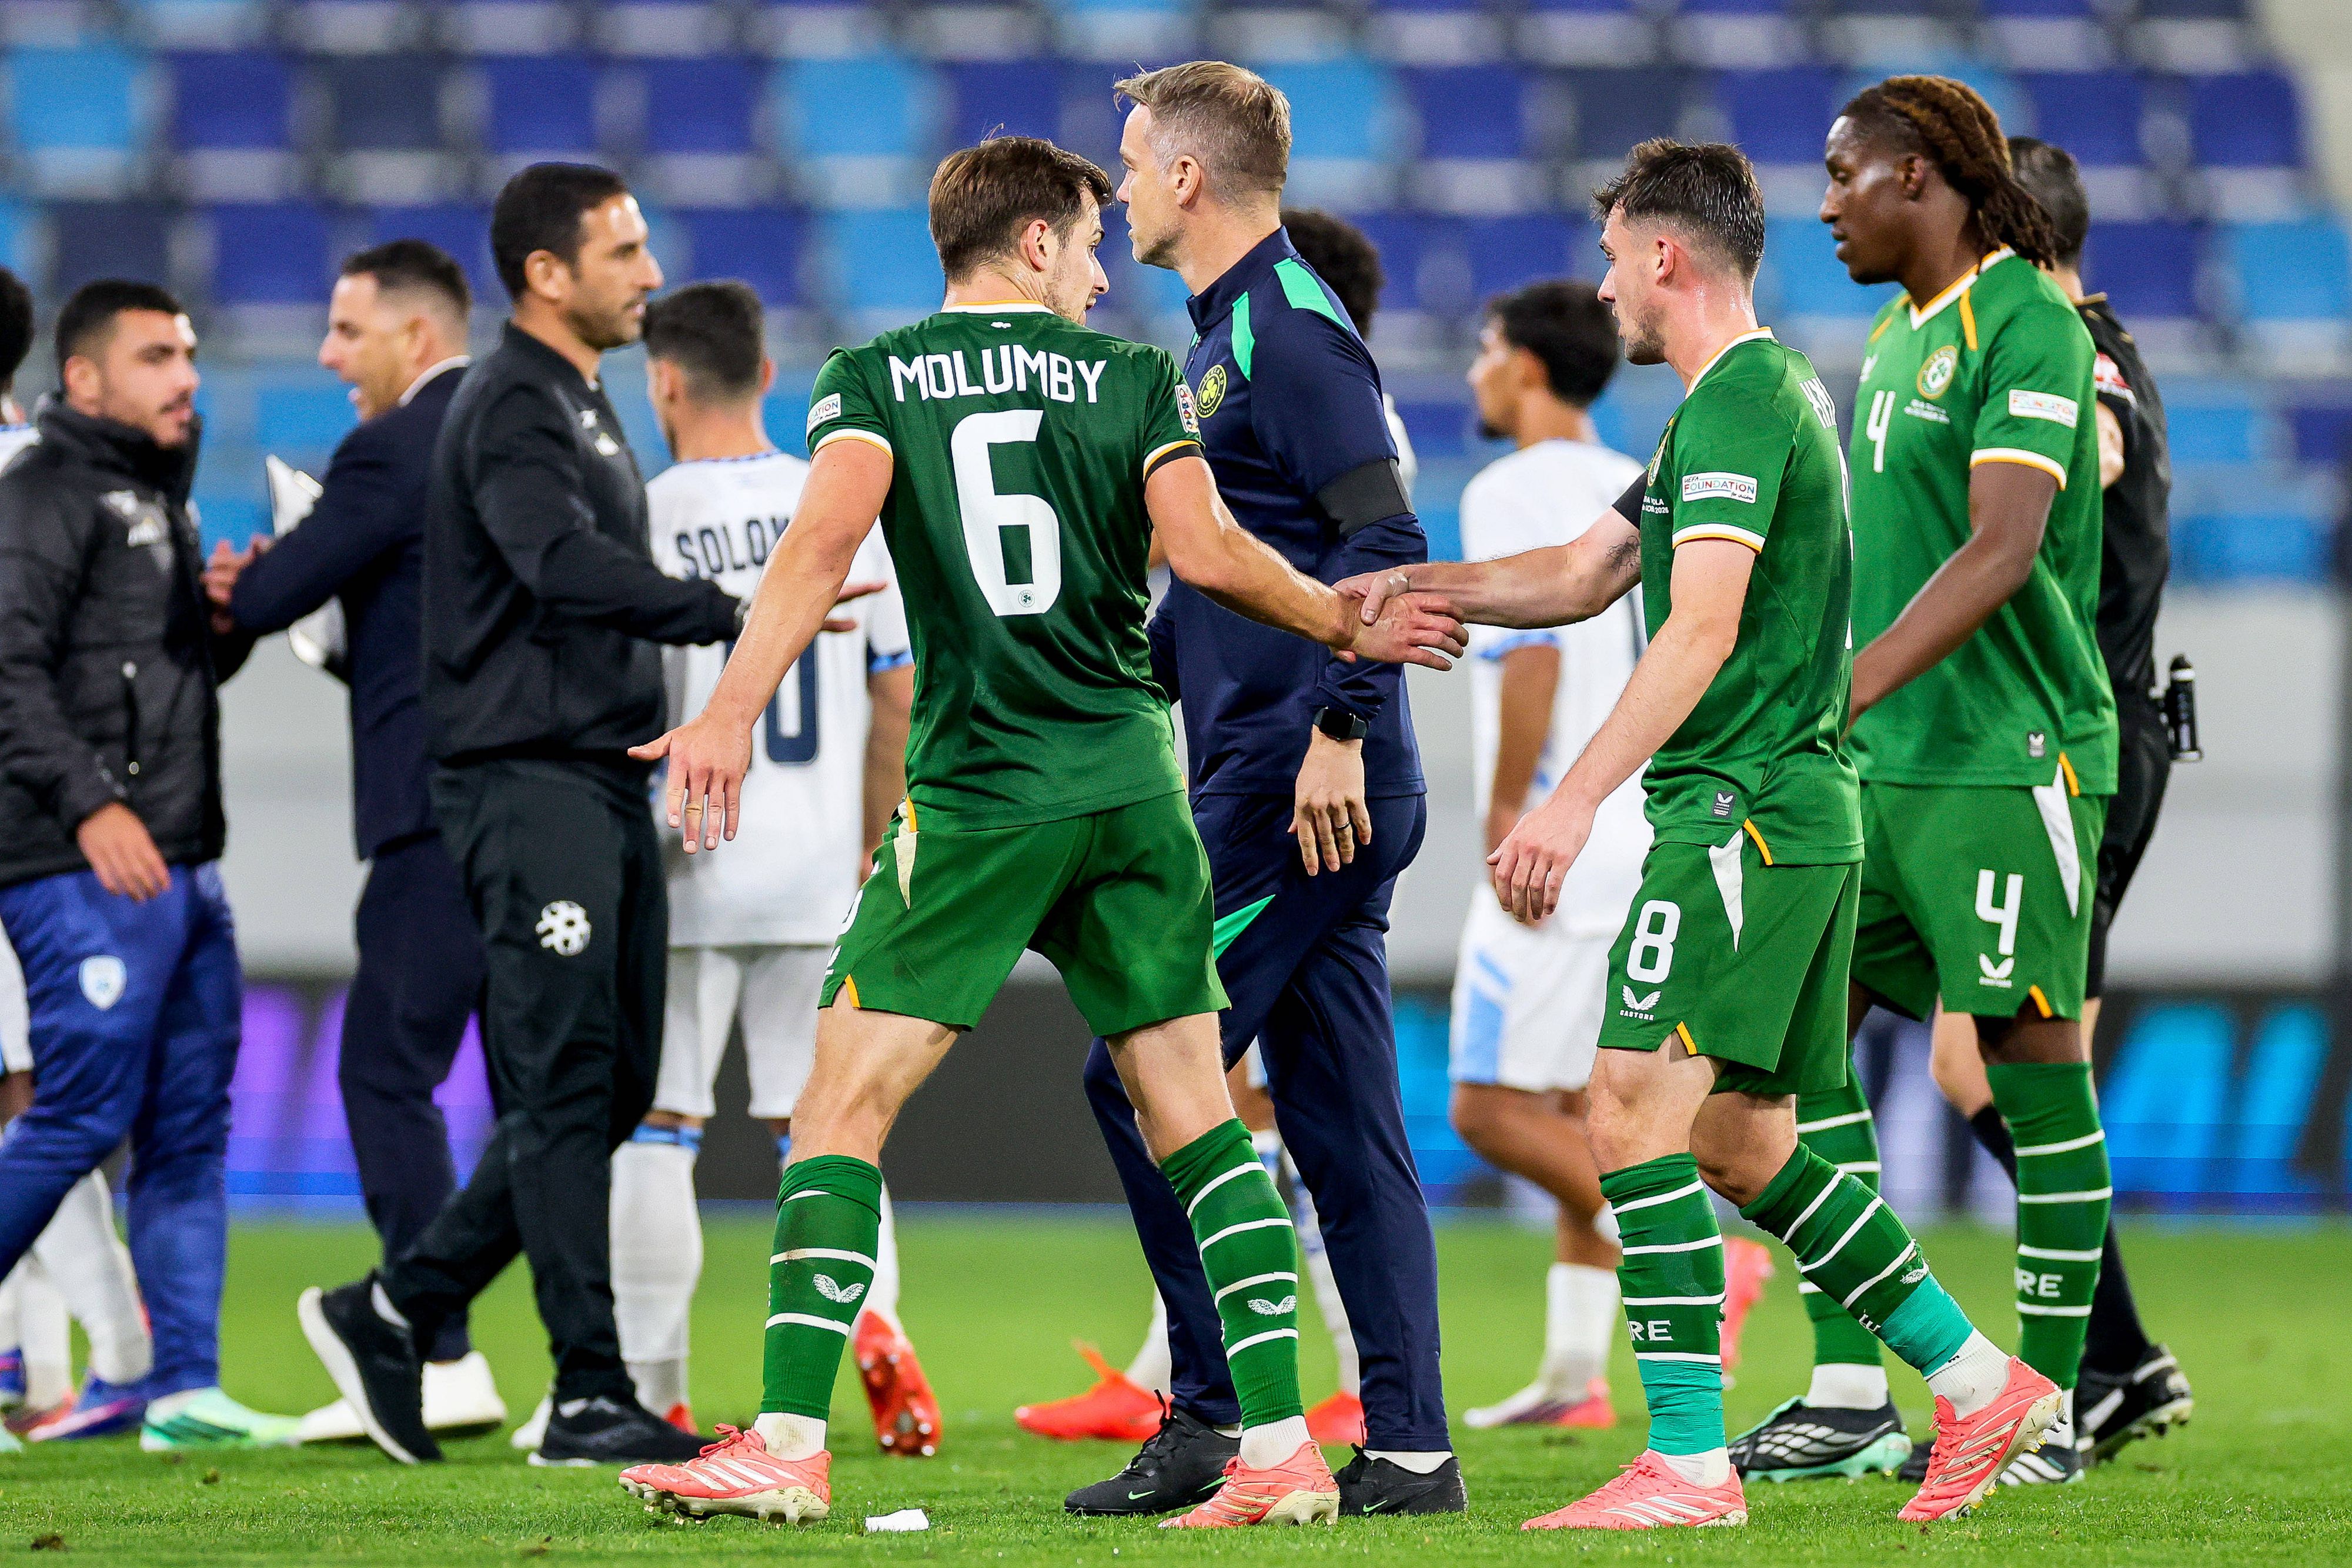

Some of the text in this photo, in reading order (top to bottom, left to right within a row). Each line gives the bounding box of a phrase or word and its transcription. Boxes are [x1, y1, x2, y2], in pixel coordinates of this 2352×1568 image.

[888, 344, 1107, 403] MOLUMBY
[1866, 390, 1895, 473] 4
[951, 409, 1062, 617] 6
[1685, 480, 1755, 494] FOUNDATION
[1626, 900, 1681, 984] 8
[1975, 869, 2023, 955] 4
[1626, 1320, 1674, 1341] RE
